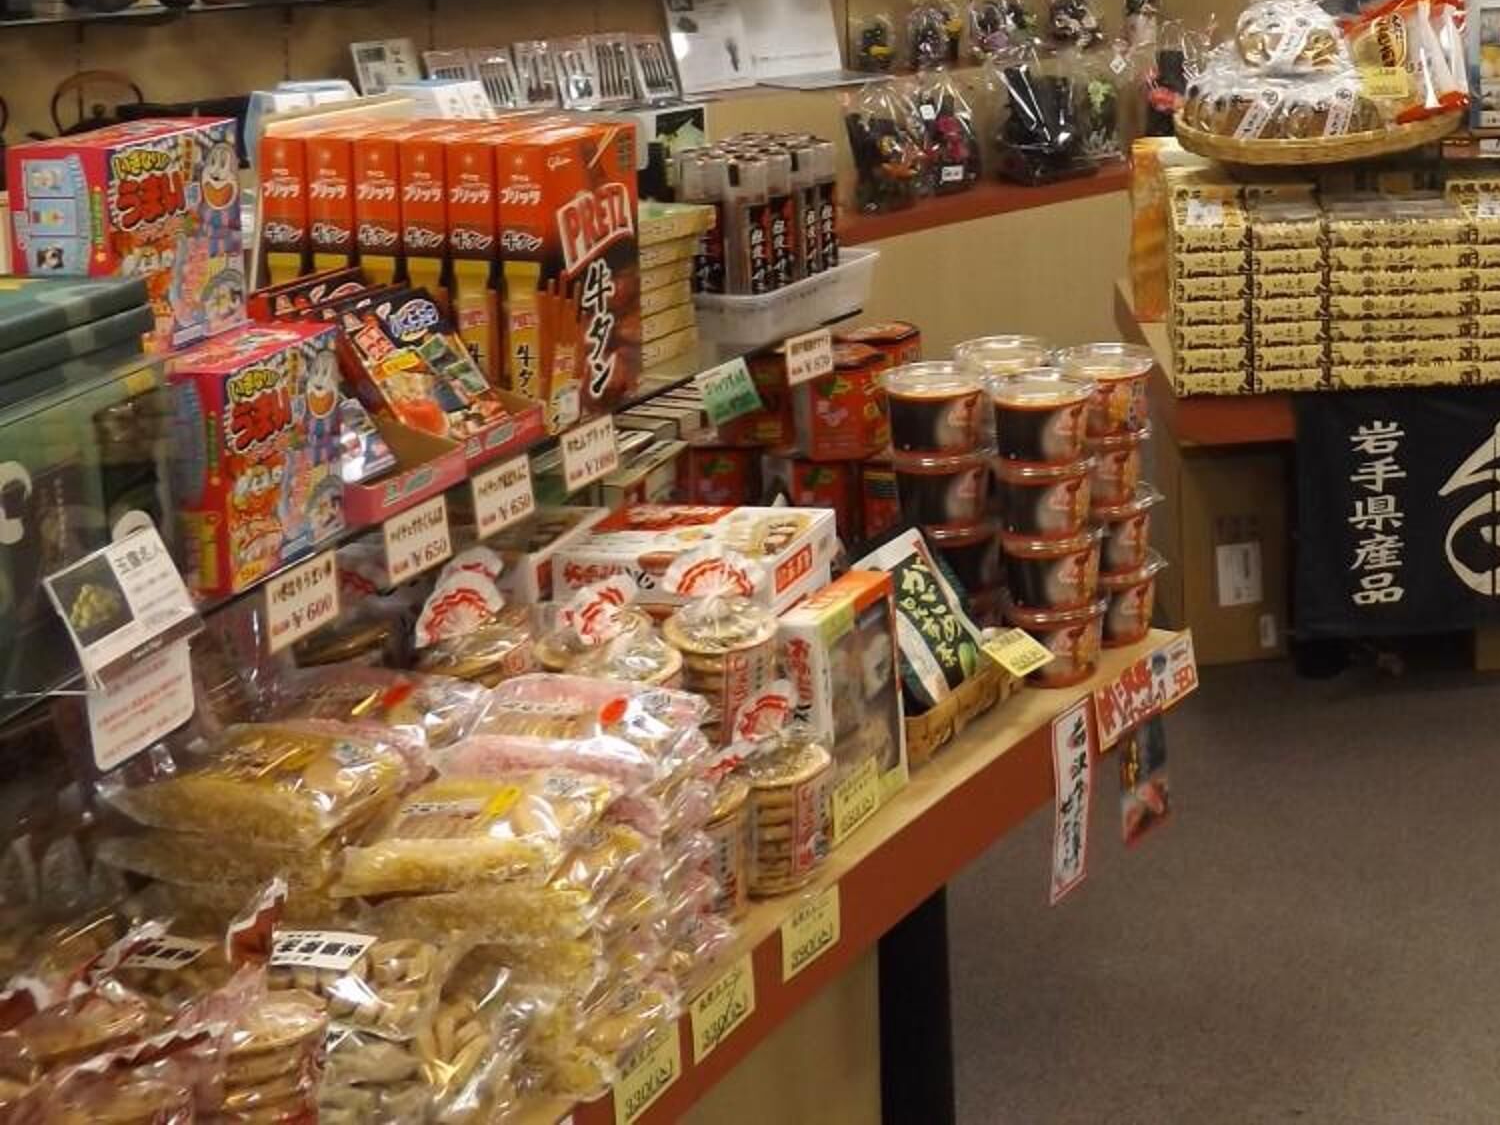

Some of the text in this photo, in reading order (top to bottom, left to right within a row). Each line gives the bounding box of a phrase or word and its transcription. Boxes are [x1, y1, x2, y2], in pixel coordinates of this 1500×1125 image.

[561, 186, 631, 267] PRETZ
[581, 258, 616, 399] 牛タン
[1349, 420, 1406, 605] 岩手県産品
